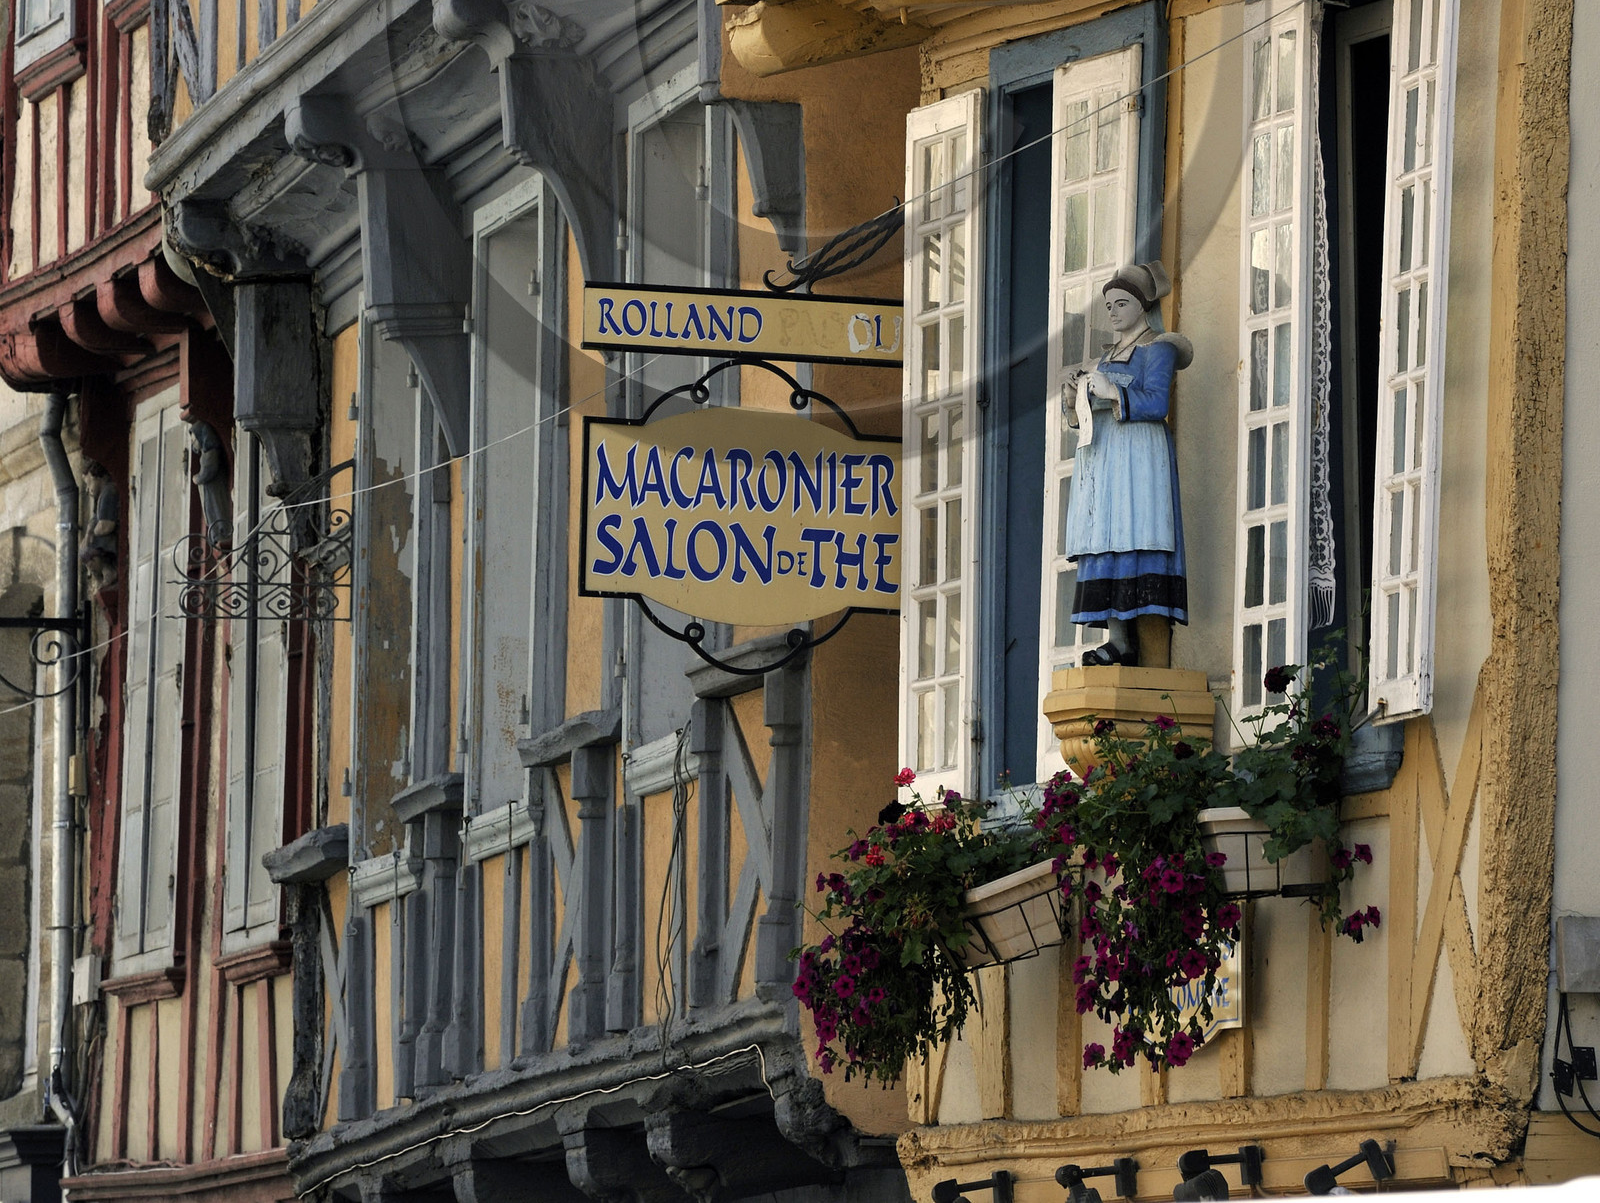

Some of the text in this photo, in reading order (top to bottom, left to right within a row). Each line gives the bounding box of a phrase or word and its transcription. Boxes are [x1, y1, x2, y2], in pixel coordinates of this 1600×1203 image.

[597, 297, 764, 344] ROLLAND
[593, 438, 899, 519] MACARONIER
[592, 513, 900, 594] SALON DE THE
